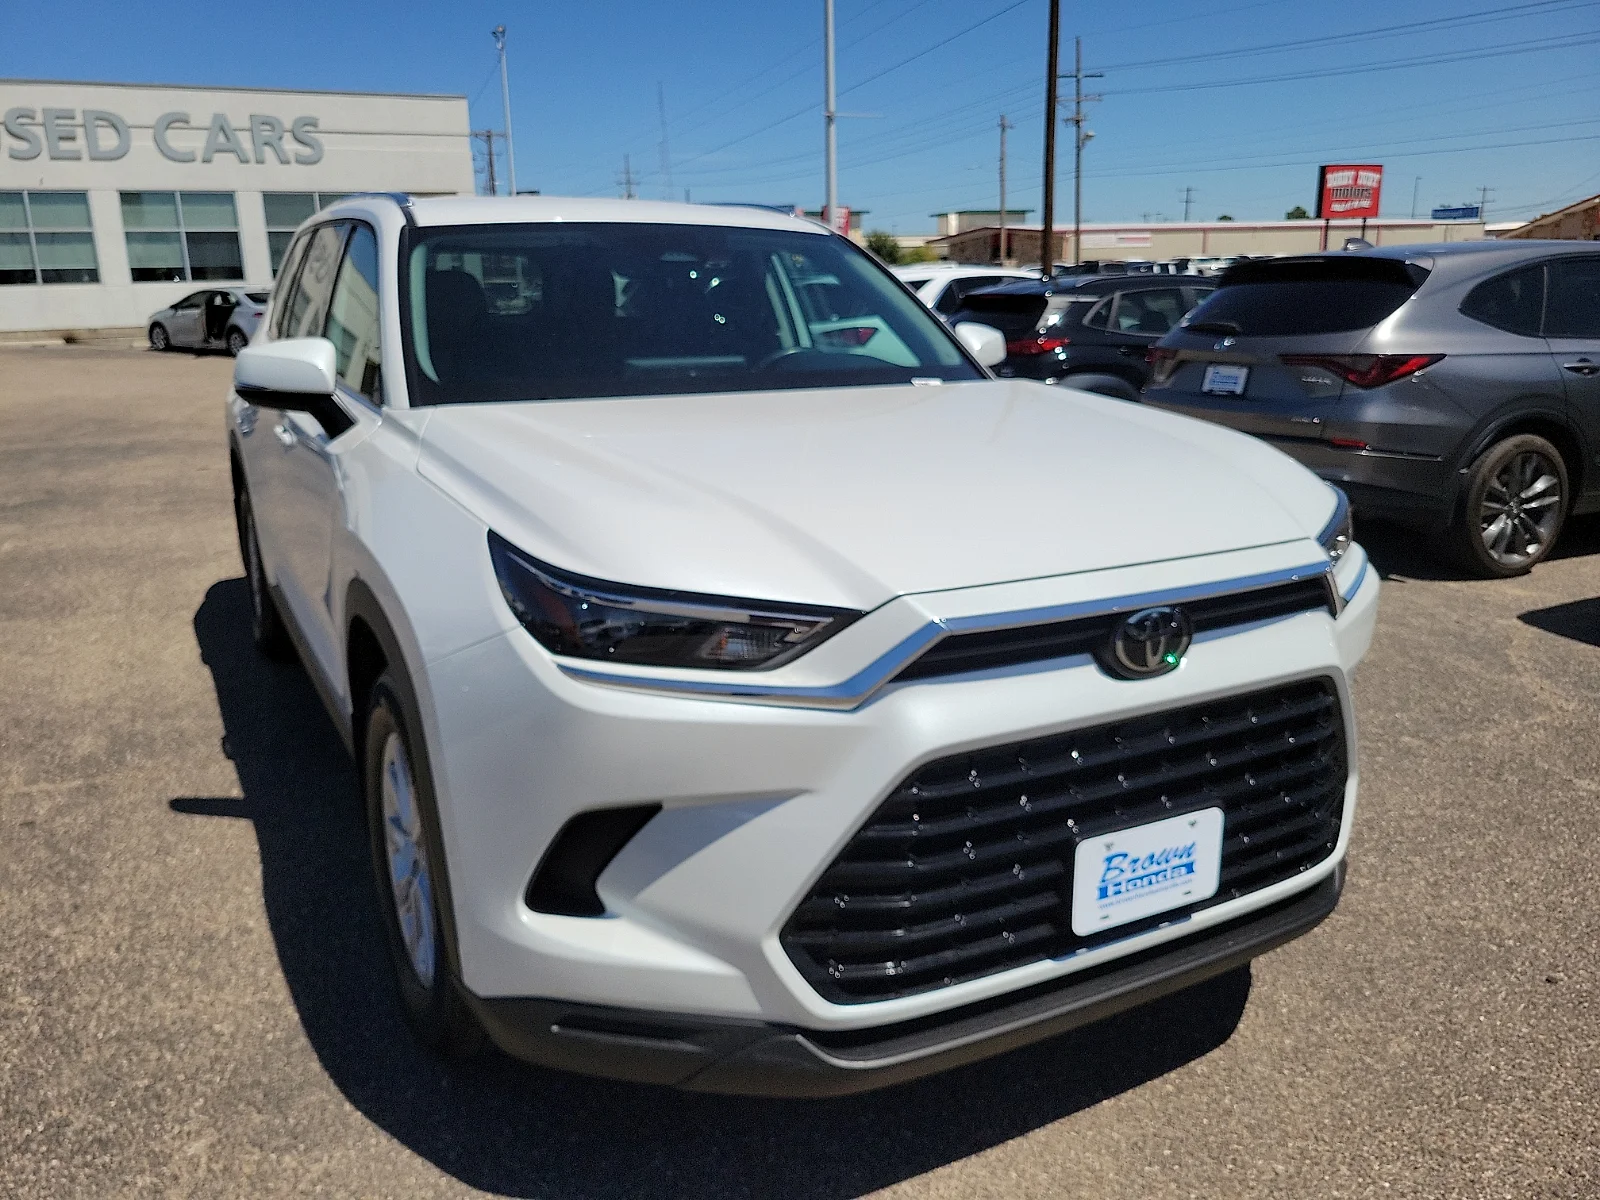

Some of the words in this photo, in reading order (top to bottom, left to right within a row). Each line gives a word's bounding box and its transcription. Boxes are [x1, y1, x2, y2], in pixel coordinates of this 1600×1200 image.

[0, 107, 131, 161] SED
[154, 112, 324, 165] CARS
[1102, 842, 1196, 883] Brown
[1103, 863, 1190, 898] Honda
